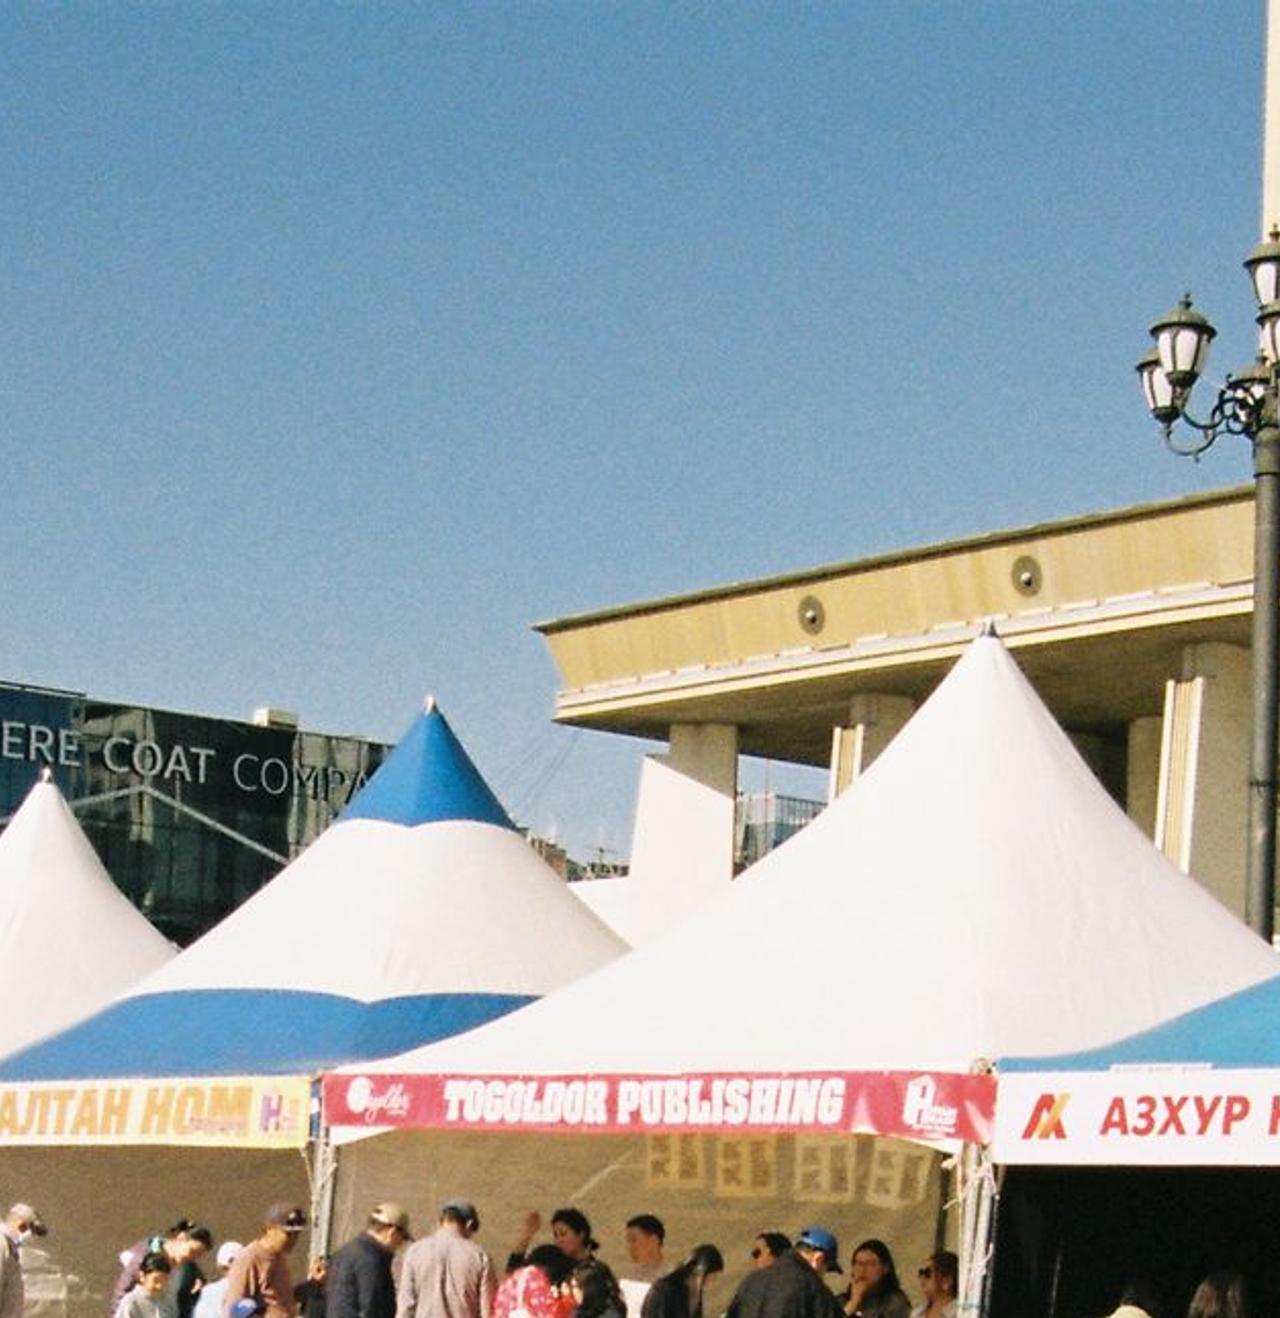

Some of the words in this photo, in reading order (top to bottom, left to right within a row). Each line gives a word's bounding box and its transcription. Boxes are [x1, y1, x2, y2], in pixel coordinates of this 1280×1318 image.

[103, 737, 215, 783] COAT
[140, 1085, 255, 1137] НОМ
[441, 1078, 608, 1125] TOGOLDOR
[616, 1077, 847, 1125] PUBLISHING
[1100, 1095, 1251, 1137] АЗХУР
